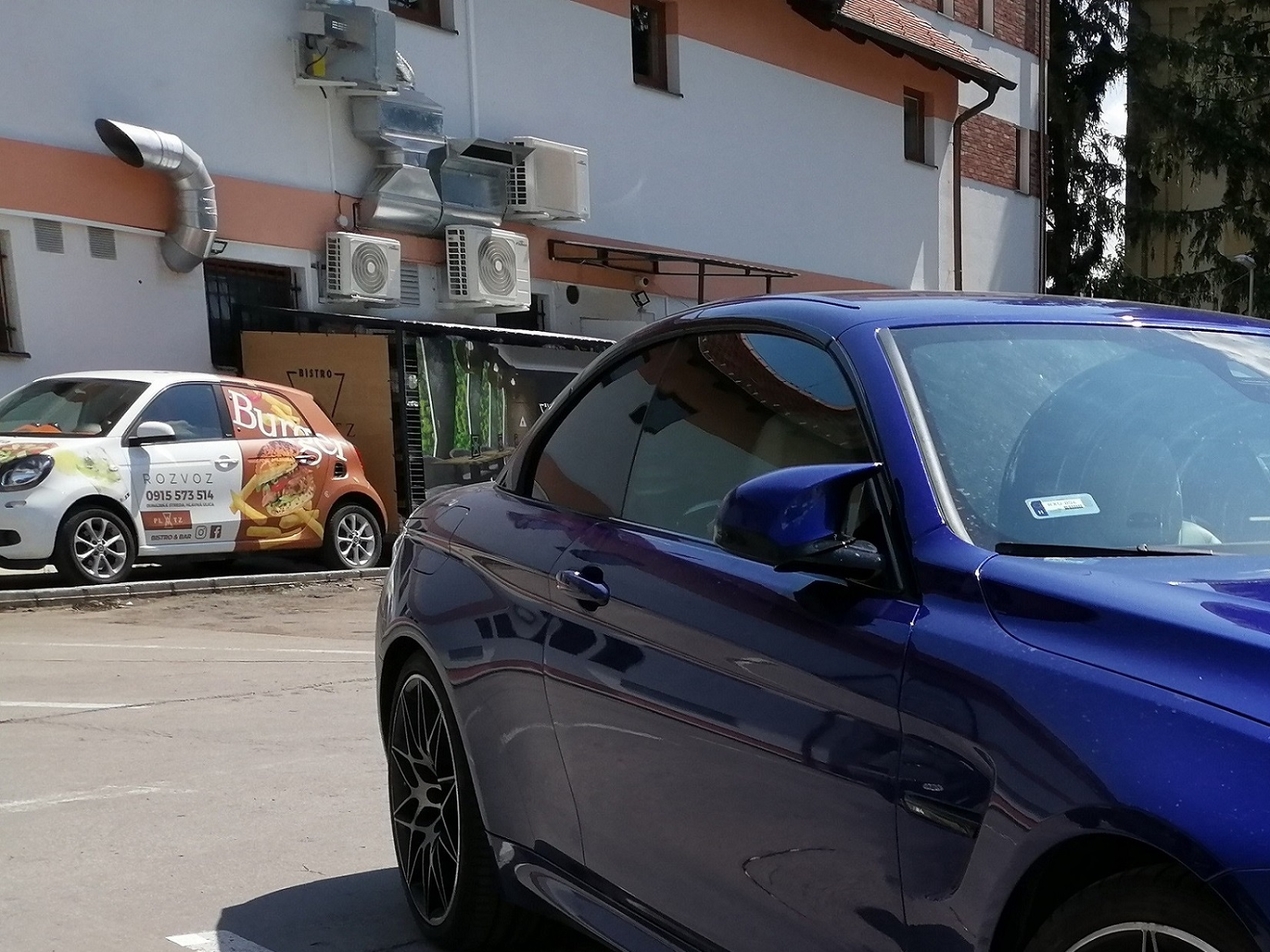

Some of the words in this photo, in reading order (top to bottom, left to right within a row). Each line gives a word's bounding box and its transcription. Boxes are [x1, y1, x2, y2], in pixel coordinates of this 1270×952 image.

[297, 368, 333, 379] BISTRO
[227, 389, 348, 467] Burger
[142, 473, 214, 485] ROZVOZ
[145, 490, 173, 501] 0915
[174, 489, 195, 501] 573
[196, 488, 215, 500] 514
[179, 532, 192, 540] BAR
